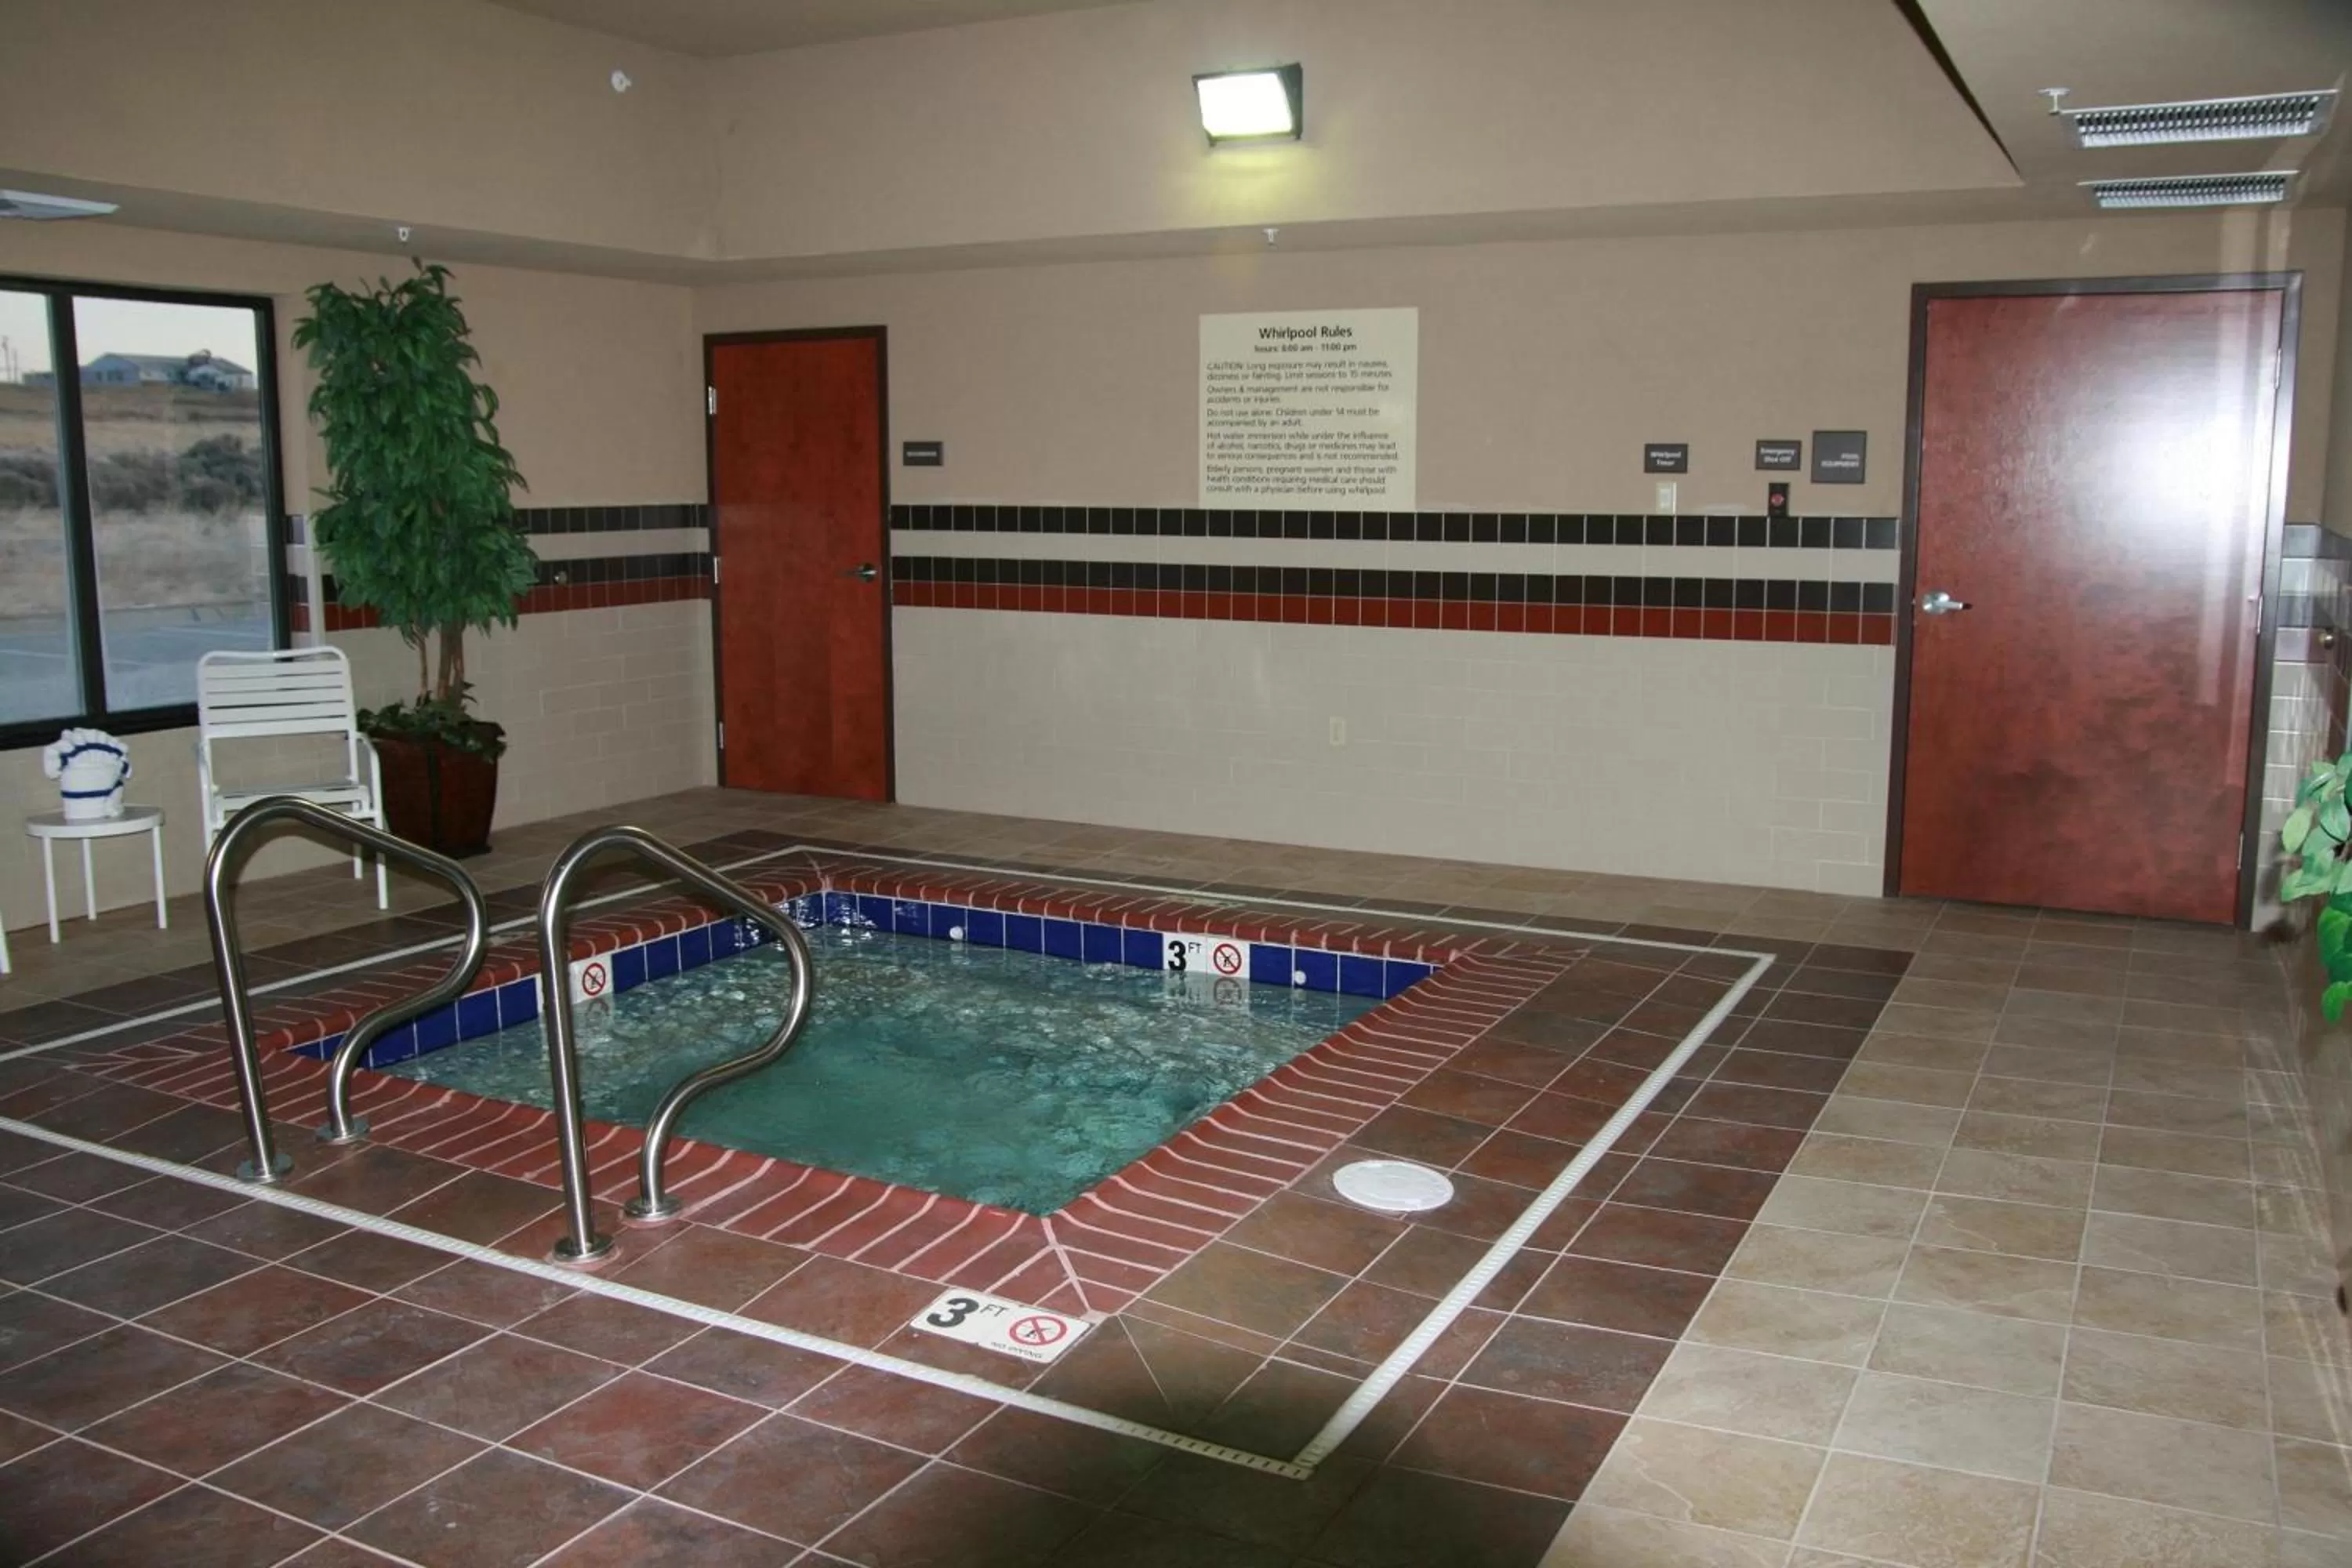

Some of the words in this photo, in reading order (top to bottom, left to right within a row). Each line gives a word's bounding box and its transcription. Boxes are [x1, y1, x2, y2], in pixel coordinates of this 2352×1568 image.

[1258, 326, 1317, 340] Whirlpool
[1321, 325, 1352, 337] Rules
[1343, 344, 1357, 353] pm
[1247, 386, 1298, 395] management
[1331, 384, 1375, 394] responsible
[1377, 382, 1388, 392] for
[1207, 408, 1218, 417] Do
[1276, 408, 1307, 416] Children
[1309, 408, 1331, 416] under
[1207, 419, 1256, 428] accompanied
[1258, 419, 1267, 428] by
[1288, 431, 1309, 440] while
[1311, 431, 1334, 440] under
[1337, 431, 1351, 440] the
[1352, 430, 1389, 440] influence
[1284, 441, 1305, 452] drugs
[1359, 443, 1376, 452] may
[1244, 453, 1297, 462] consequences
[1299, 452, 1314, 460] and
[1207, 464, 1231, 474] Elderly
[1267, 466, 1301, 475] pregnant
[1377, 465, 1397, 474] with
[1207, 474, 1229, 483] health
[1272, 475, 1307, 485] requiring
[1261, 485, 1294, 495] physician
[1297, 485, 1322, 493] before
[1325, 486, 1346, 495] using
[1167, 940, 1186, 971] 3
[1188, 942, 1202, 953] FT
[927, 1298, 979, 1327] 3
[980, 1304, 1008, 1318] FT
